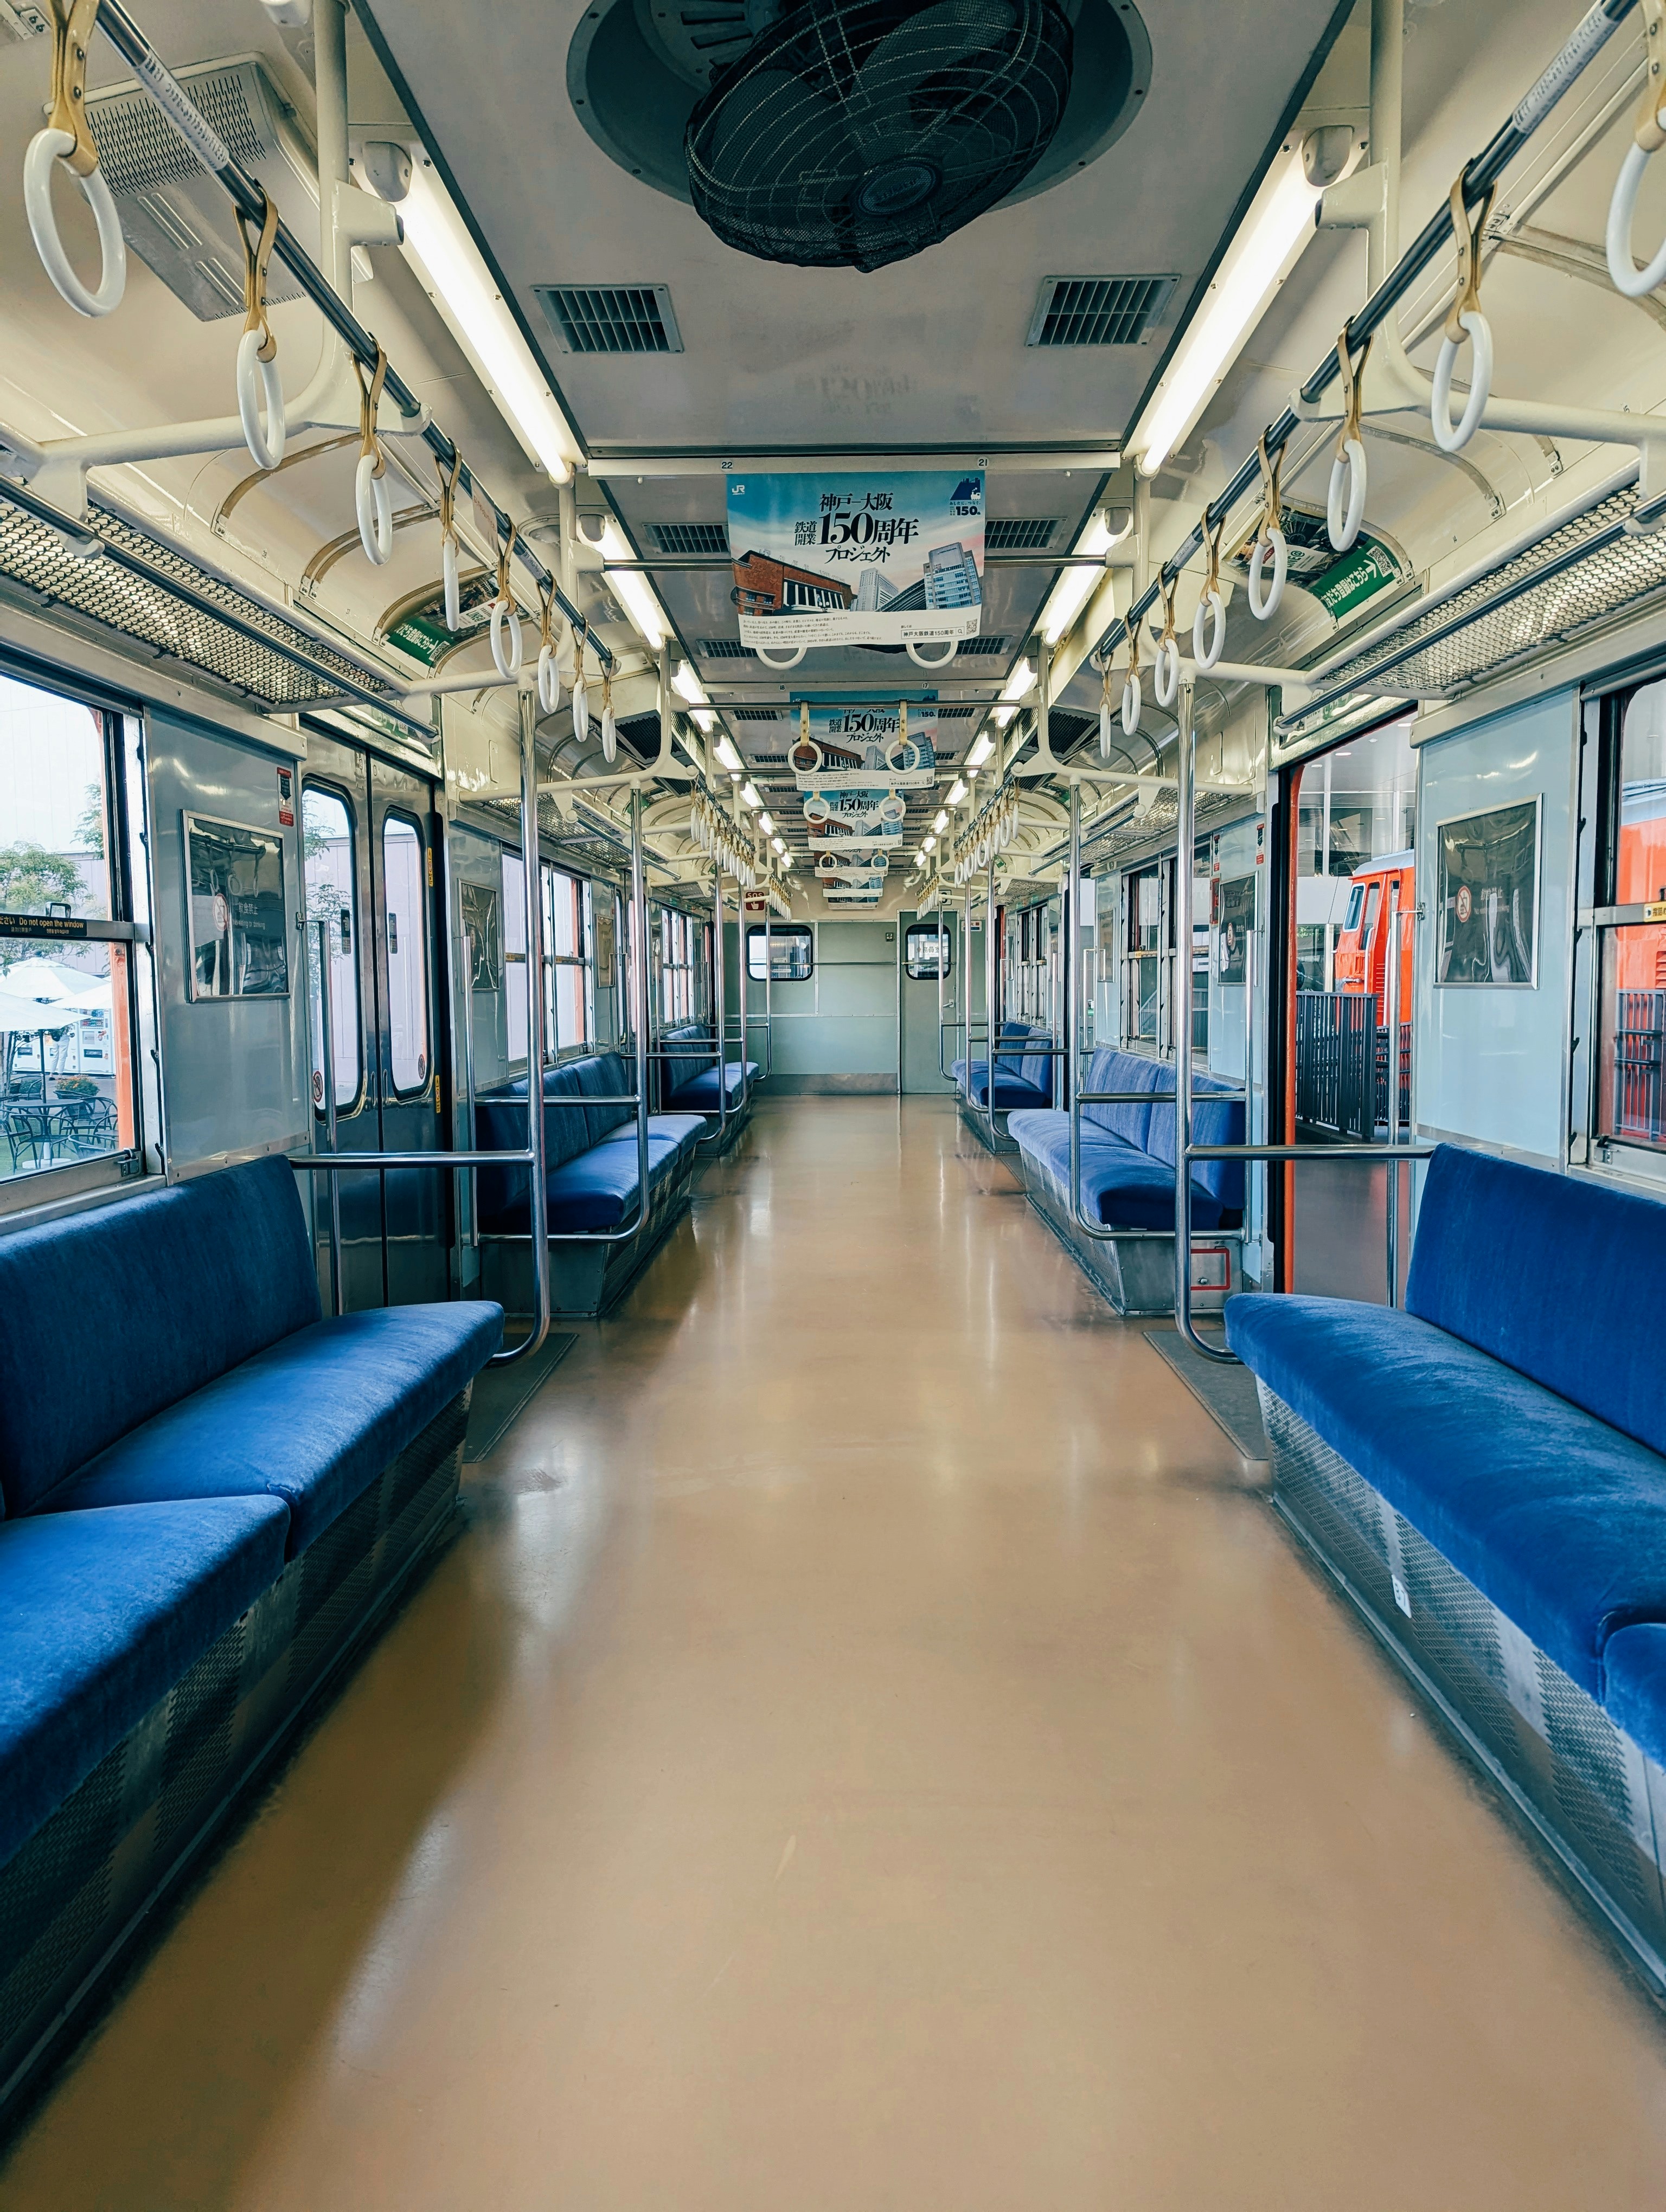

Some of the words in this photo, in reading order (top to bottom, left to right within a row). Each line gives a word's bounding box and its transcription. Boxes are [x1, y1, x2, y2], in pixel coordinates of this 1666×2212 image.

[732, 485, 745, 493] JR
[794, 522, 817, 533] 鉄道
[794, 533, 817, 546] 開業
[824, 545, 890, 564] プロジェクト
[846, 733, 884, 743] プロジェクト
[64, 920, 84, 928] window
